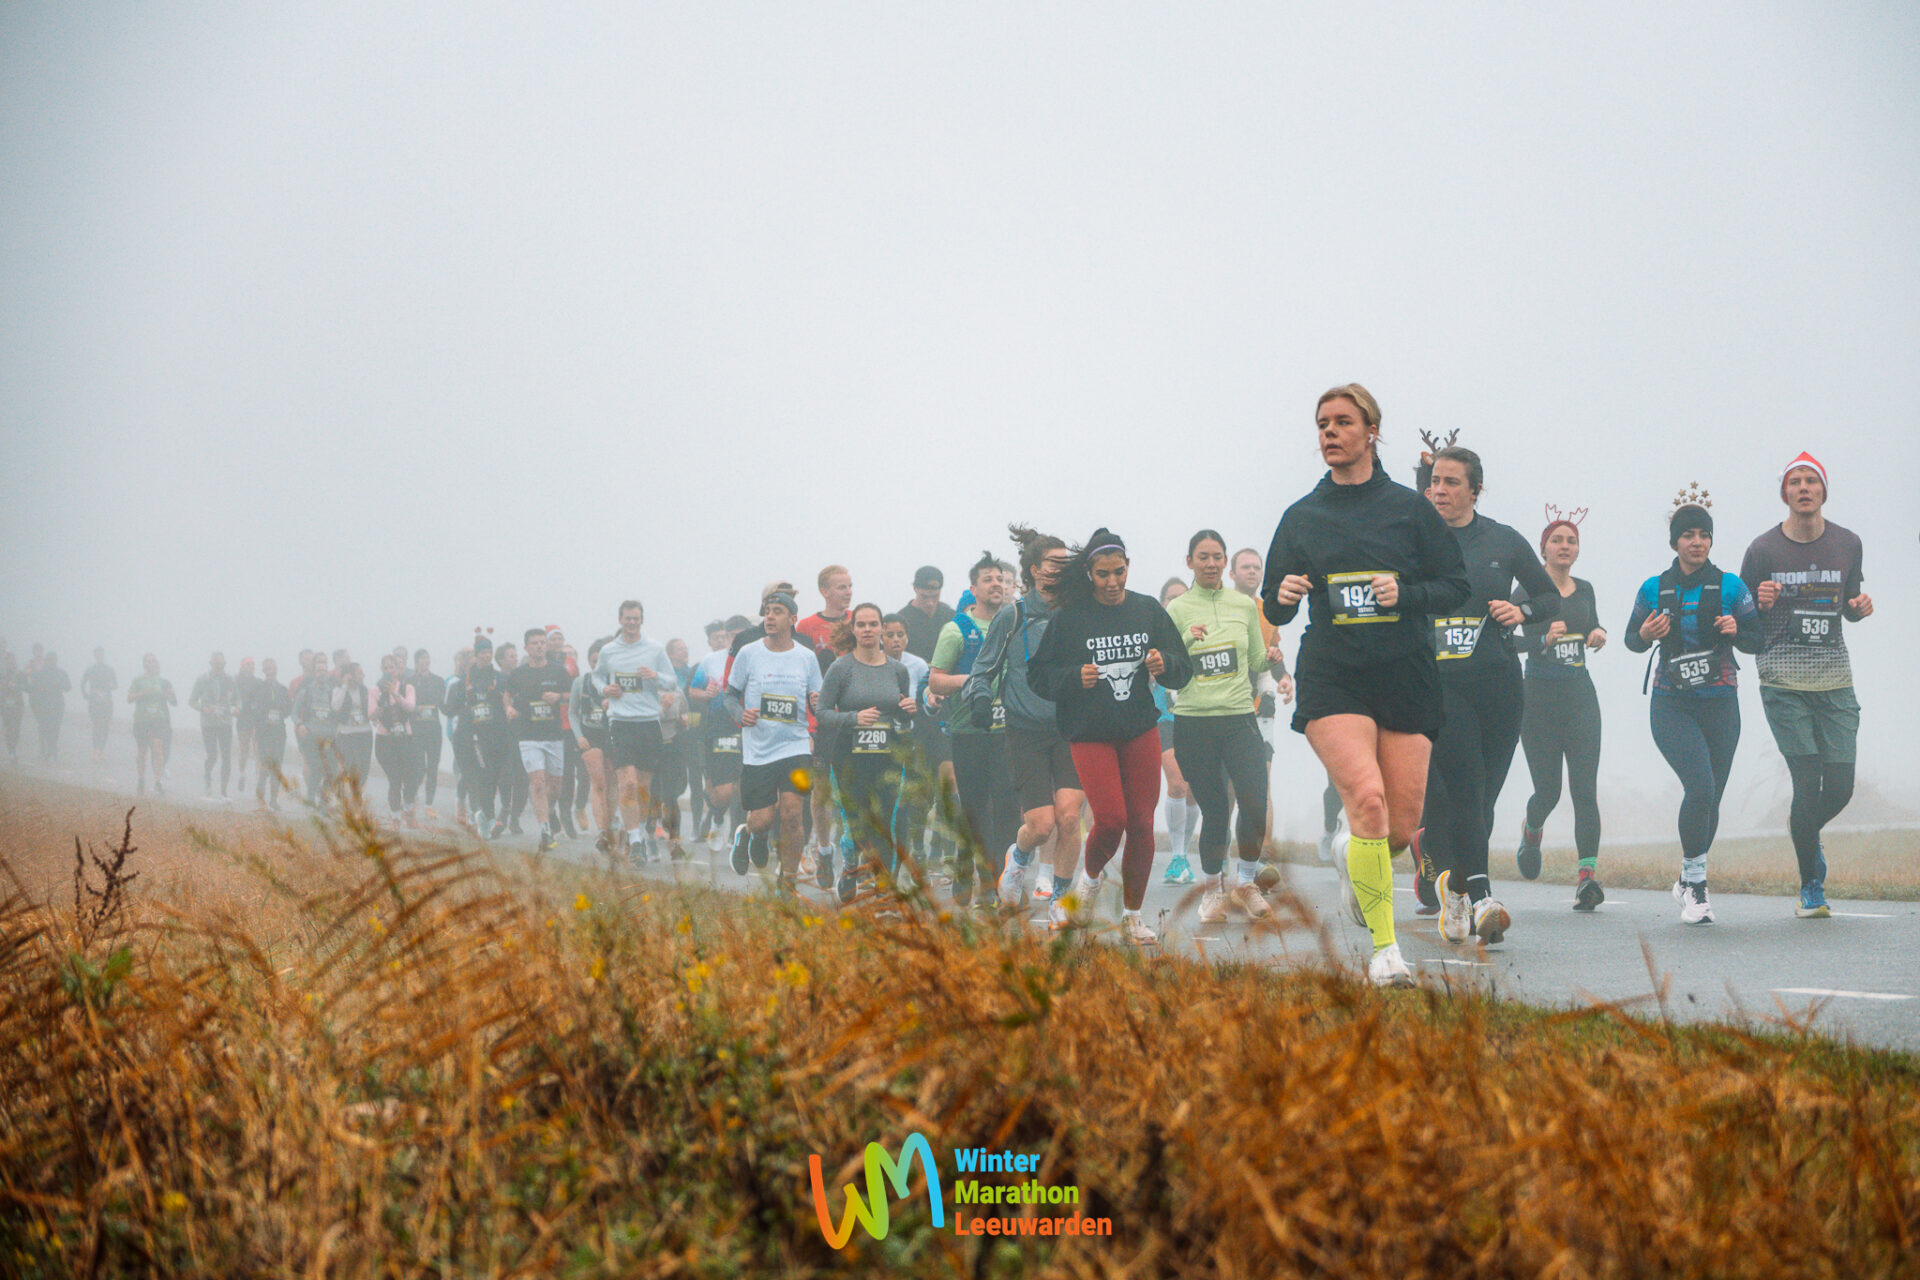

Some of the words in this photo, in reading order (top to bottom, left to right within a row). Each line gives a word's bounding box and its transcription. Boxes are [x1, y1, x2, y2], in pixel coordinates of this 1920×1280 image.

[1340, 585, 1379, 607] 192
[1801, 618, 1829, 635] 536
[1086, 632, 1149, 650] CHICAGO
[1096, 646, 1142, 661] BULLS
[1554, 642, 1579, 659] 1944
[1200, 652, 1231, 670] 1919
[1680, 658, 1710, 679] 535
[857, 730, 887, 744] 2260
